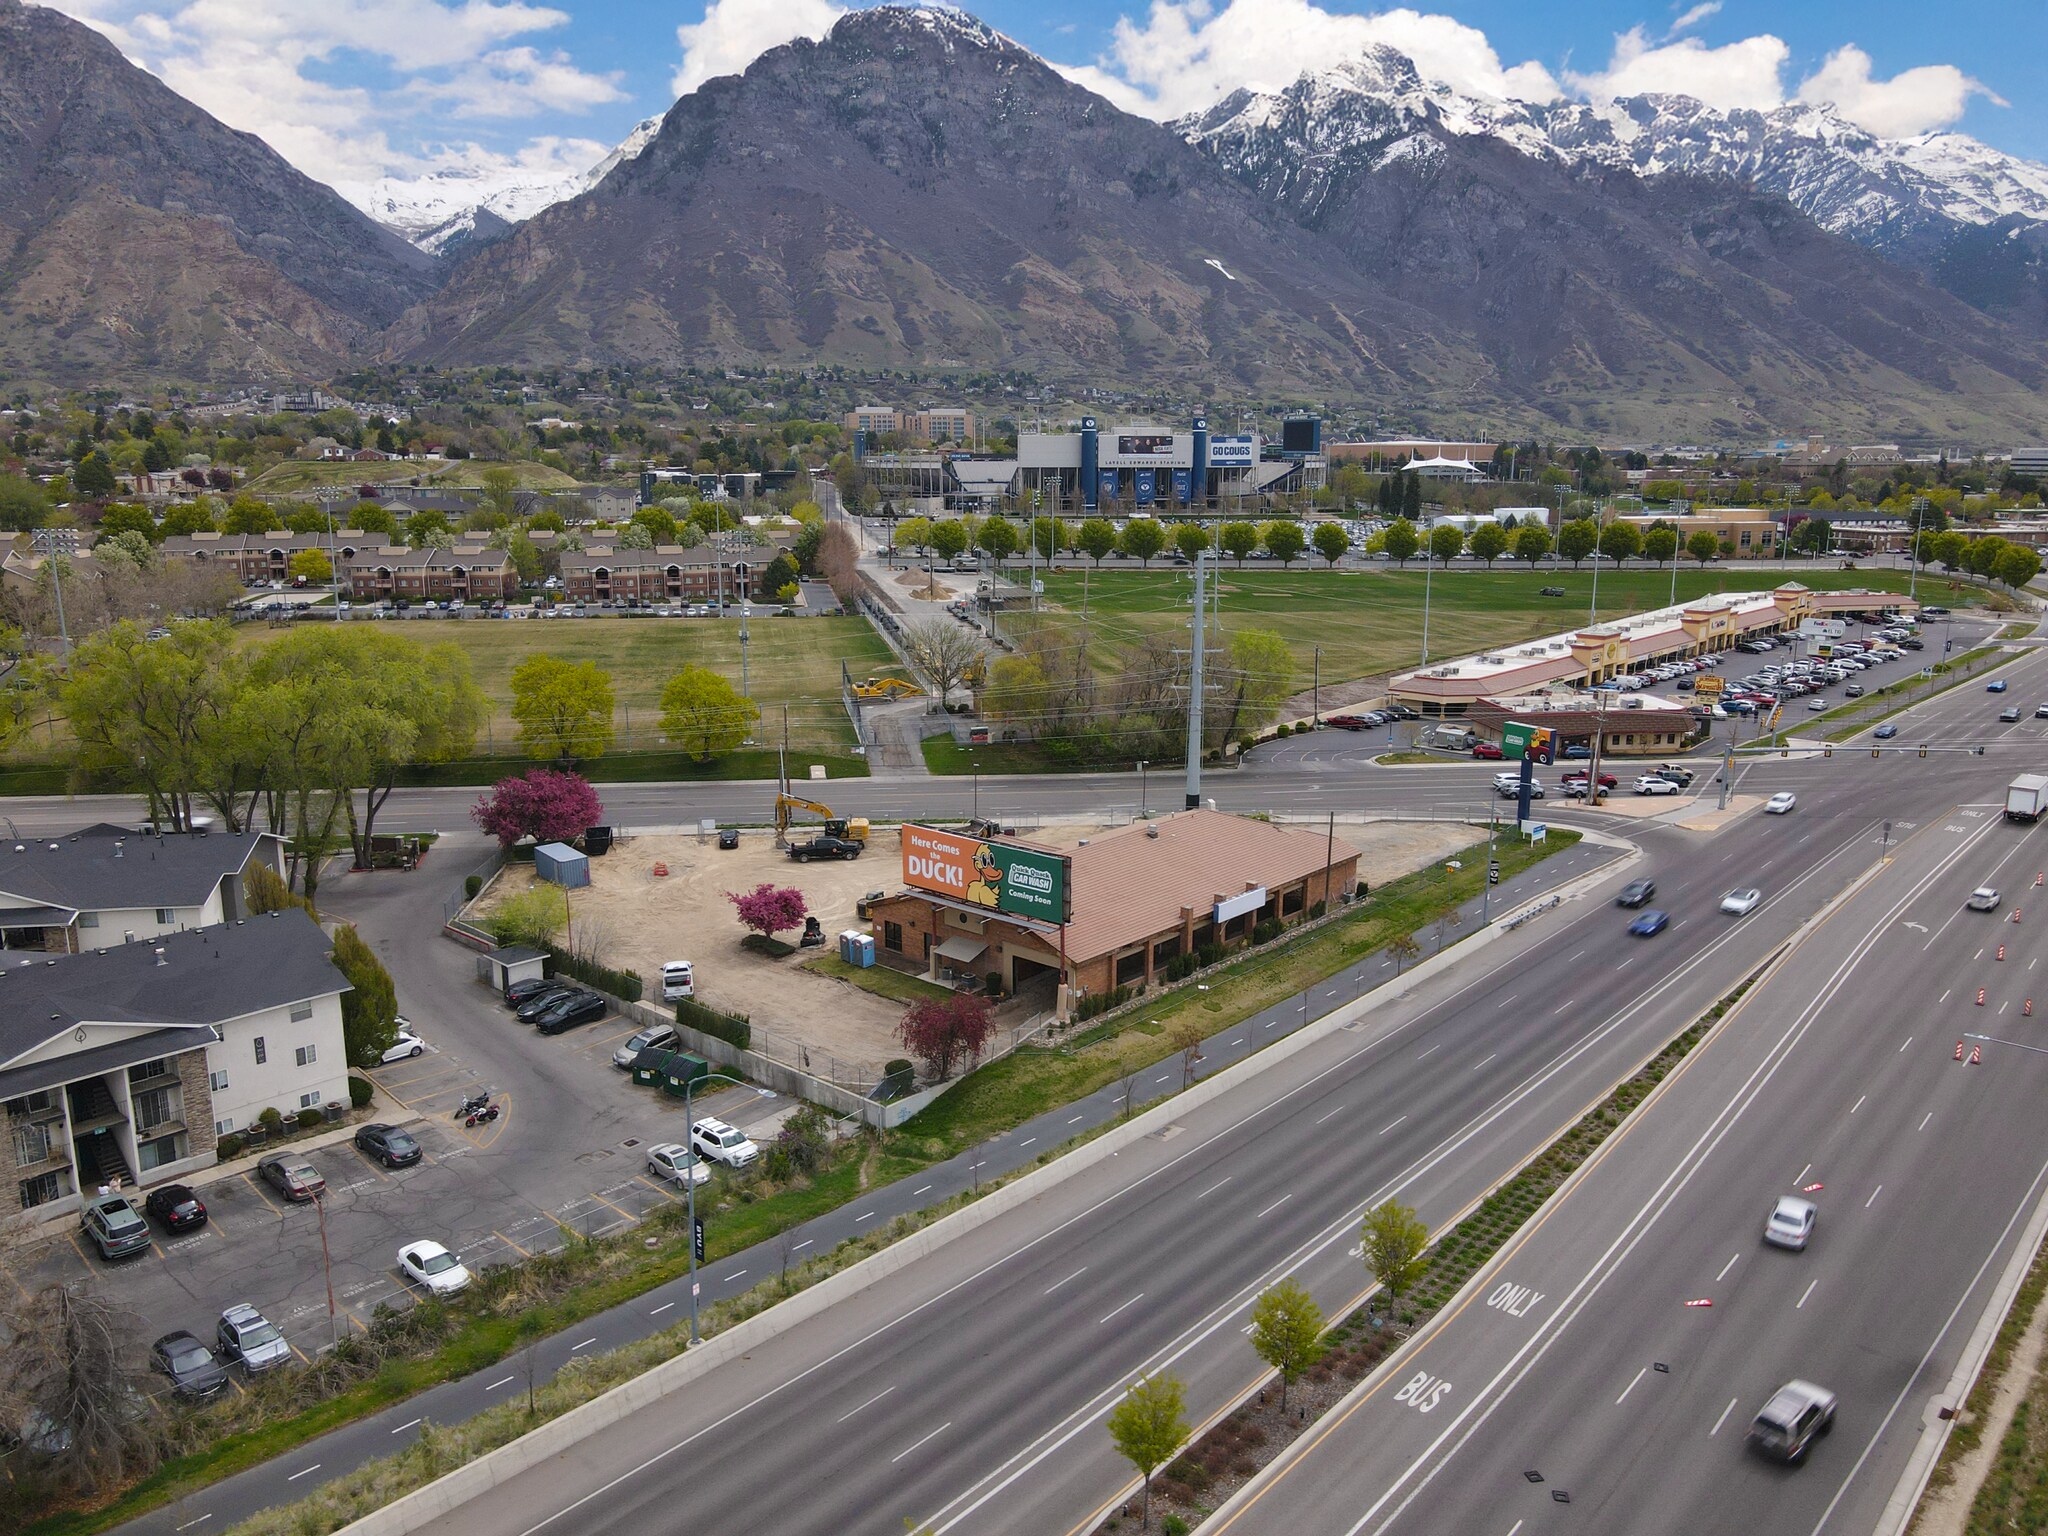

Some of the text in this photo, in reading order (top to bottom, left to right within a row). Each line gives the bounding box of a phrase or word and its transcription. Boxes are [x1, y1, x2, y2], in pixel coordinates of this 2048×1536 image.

[1212, 446, 1250, 456] GO COUGS
[1961, 810, 1986, 818] ONLY
[1895, 821, 1917, 830] BUS
[1944, 825, 1966, 833] BUS
[911, 835, 960, 856] Here Comes
[930, 852, 941, 860] the
[908, 855, 964, 888] DUCK!
[1012, 864, 1050, 878] Quick Quack
[1014, 873, 1050, 889] CAR WASH
[1008, 889, 1051, 905] Coming Soon
[166, 1232, 212, 1250] RESERVED
[1487, 1282, 1546, 1318] ONLY
[1393, 1371, 1452, 1413] BUS
